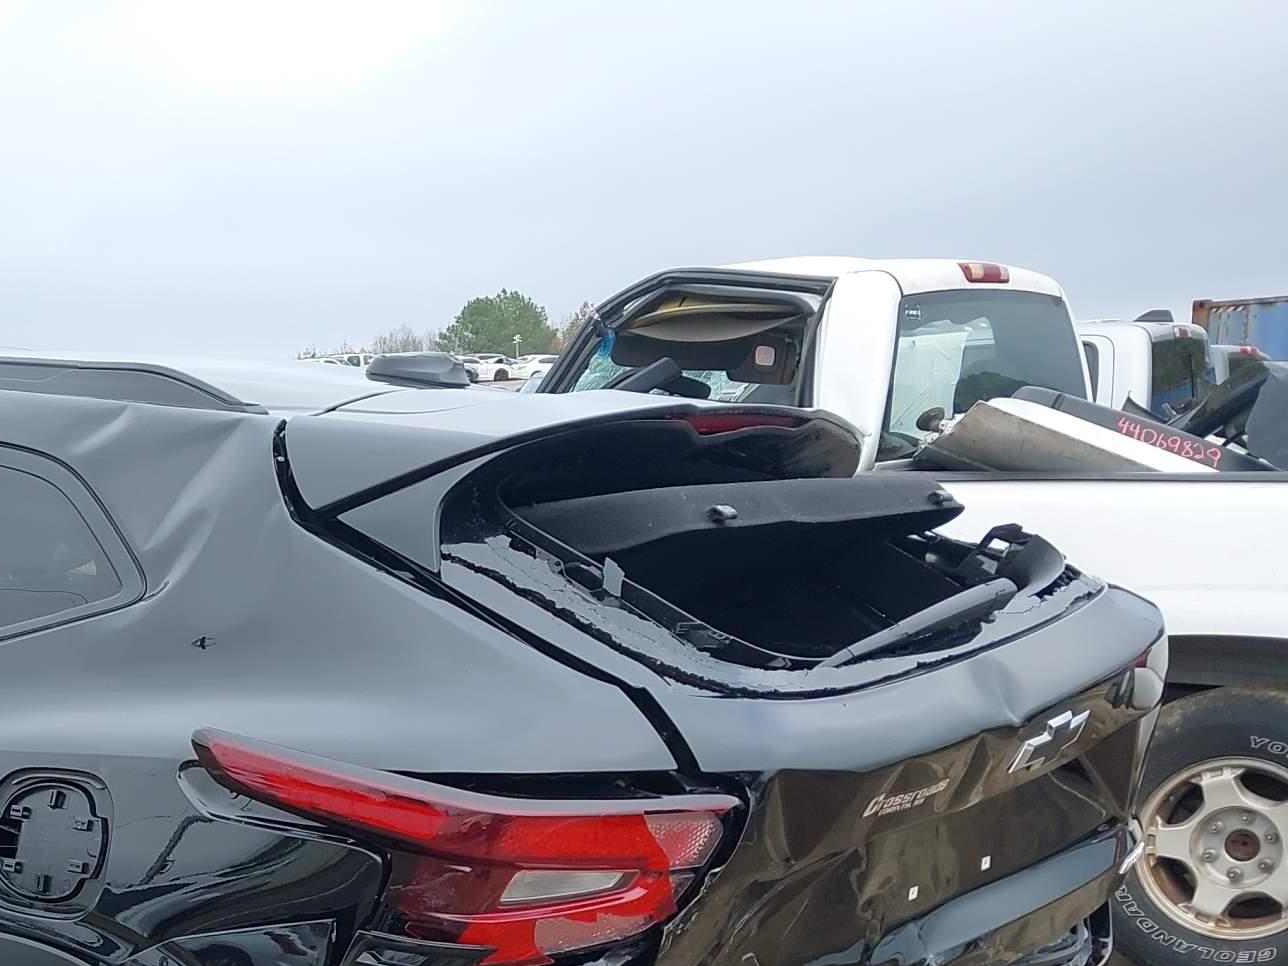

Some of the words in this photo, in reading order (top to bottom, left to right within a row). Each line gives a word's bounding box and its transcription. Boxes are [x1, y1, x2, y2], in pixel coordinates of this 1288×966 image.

[1118, 416, 1222, 468] 44069829
[862, 778, 950, 818] Crossroads
[1114, 884, 1278, 963] GEOLANDAR
